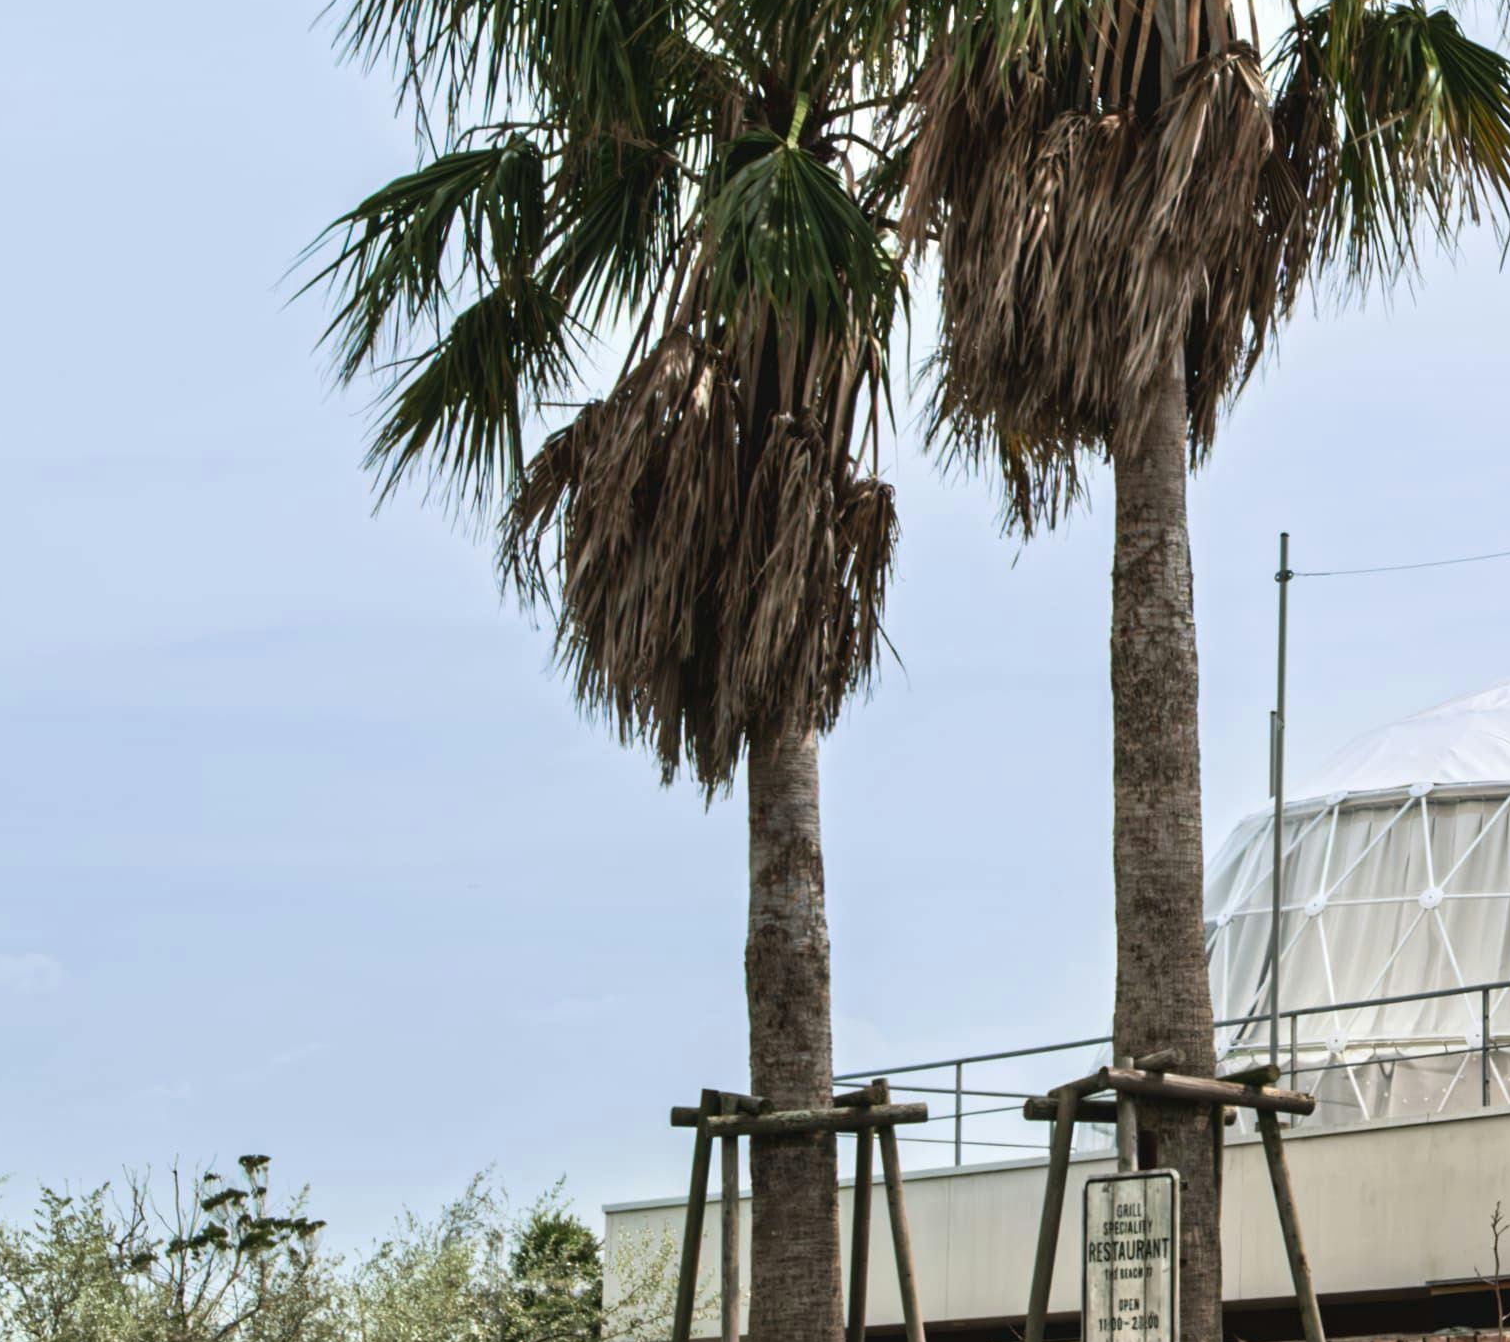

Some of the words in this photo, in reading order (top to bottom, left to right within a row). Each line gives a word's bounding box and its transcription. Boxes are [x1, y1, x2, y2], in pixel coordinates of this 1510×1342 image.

[1116, 1203, 1142, 1218] GRILL
[1102, 1219, 1153, 1236] SPECIALITY
[1088, 1237, 1170, 1263] RESTAURANT
[1118, 1298, 1140, 1311] OPEN
